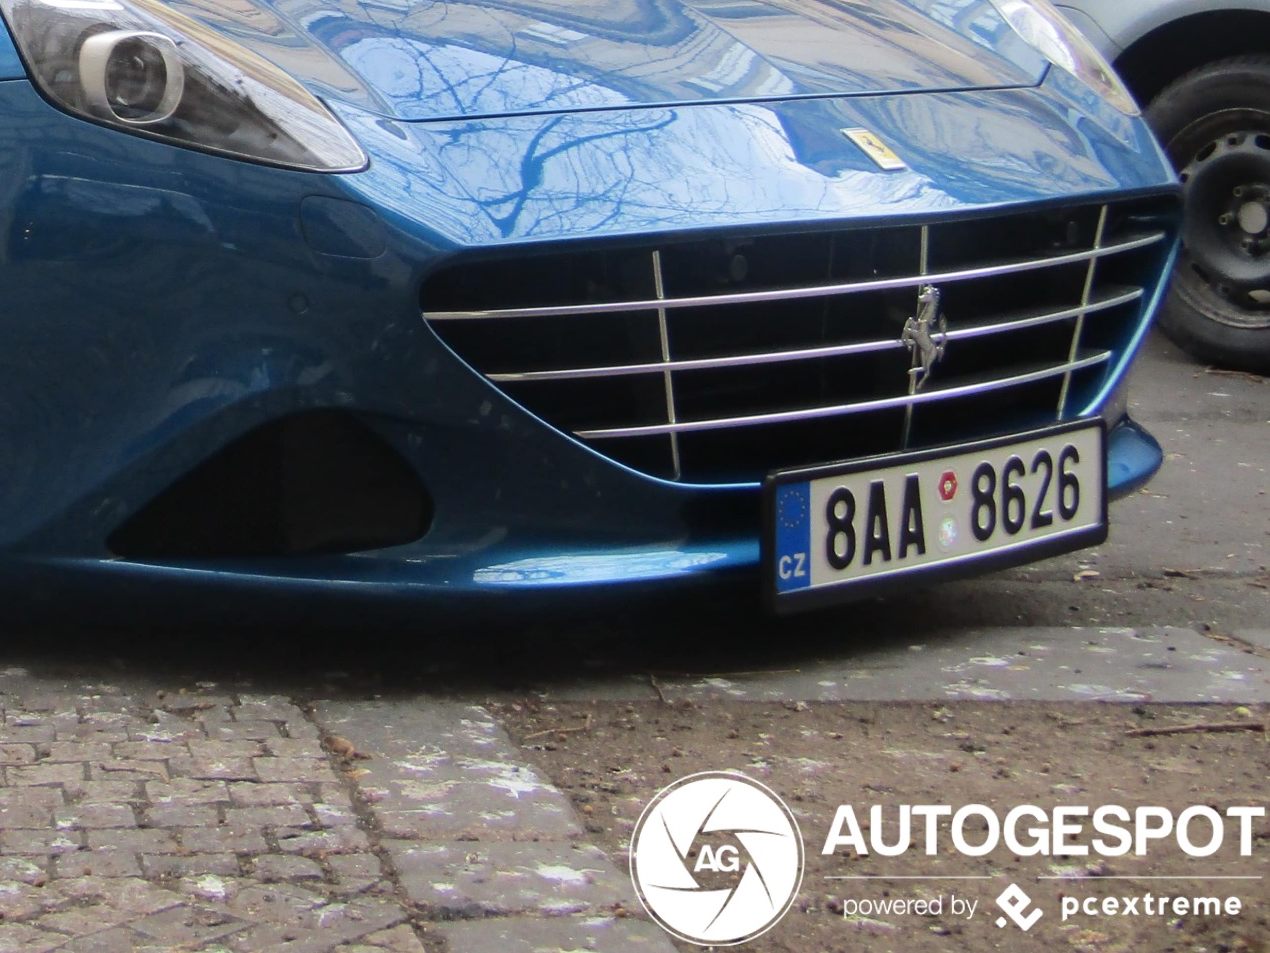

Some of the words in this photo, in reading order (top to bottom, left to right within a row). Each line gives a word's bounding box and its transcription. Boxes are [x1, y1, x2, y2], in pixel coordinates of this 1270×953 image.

[825, 484, 926, 571] 8AA
[970, 443, 1081, 542] 8626
[779, 552, 806, 580] CZ
